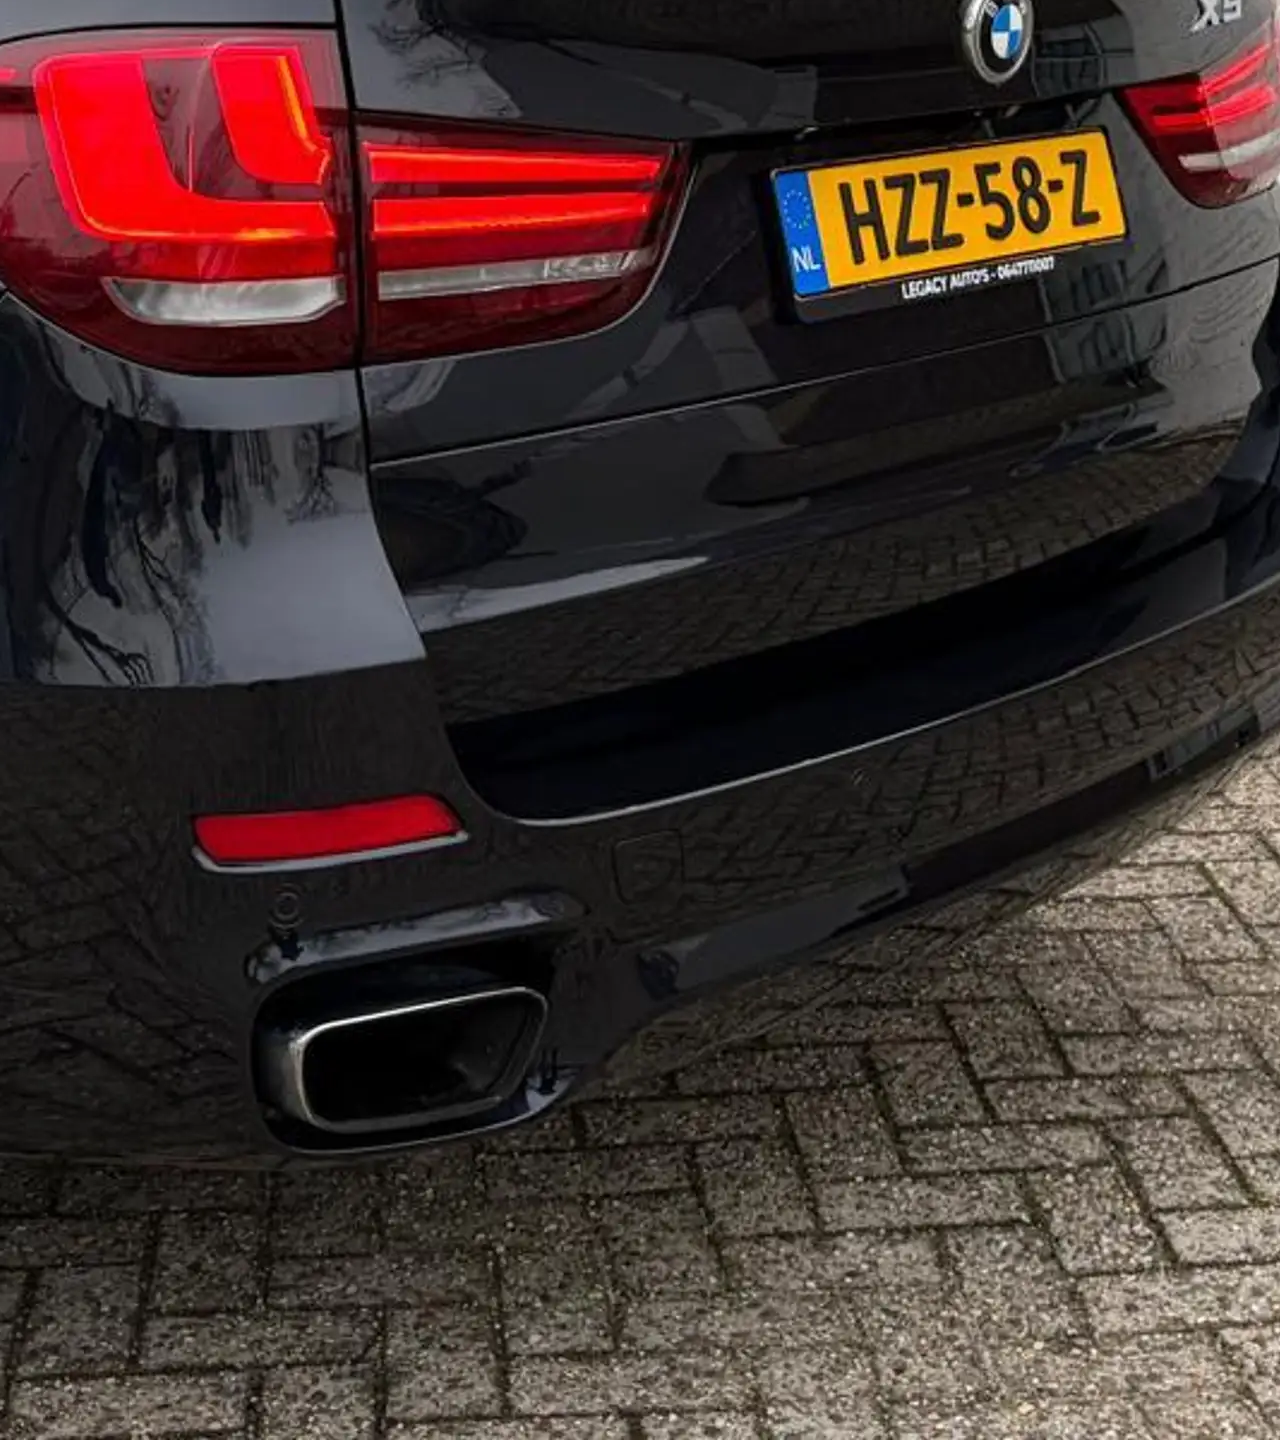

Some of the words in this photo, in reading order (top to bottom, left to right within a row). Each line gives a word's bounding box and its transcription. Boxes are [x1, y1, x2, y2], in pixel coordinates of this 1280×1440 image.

[837, 149, 1101, 265] HZZ-58-Z
[791, 245, 822, 273] NL
[901, 275, 949, 300] LEGACY
